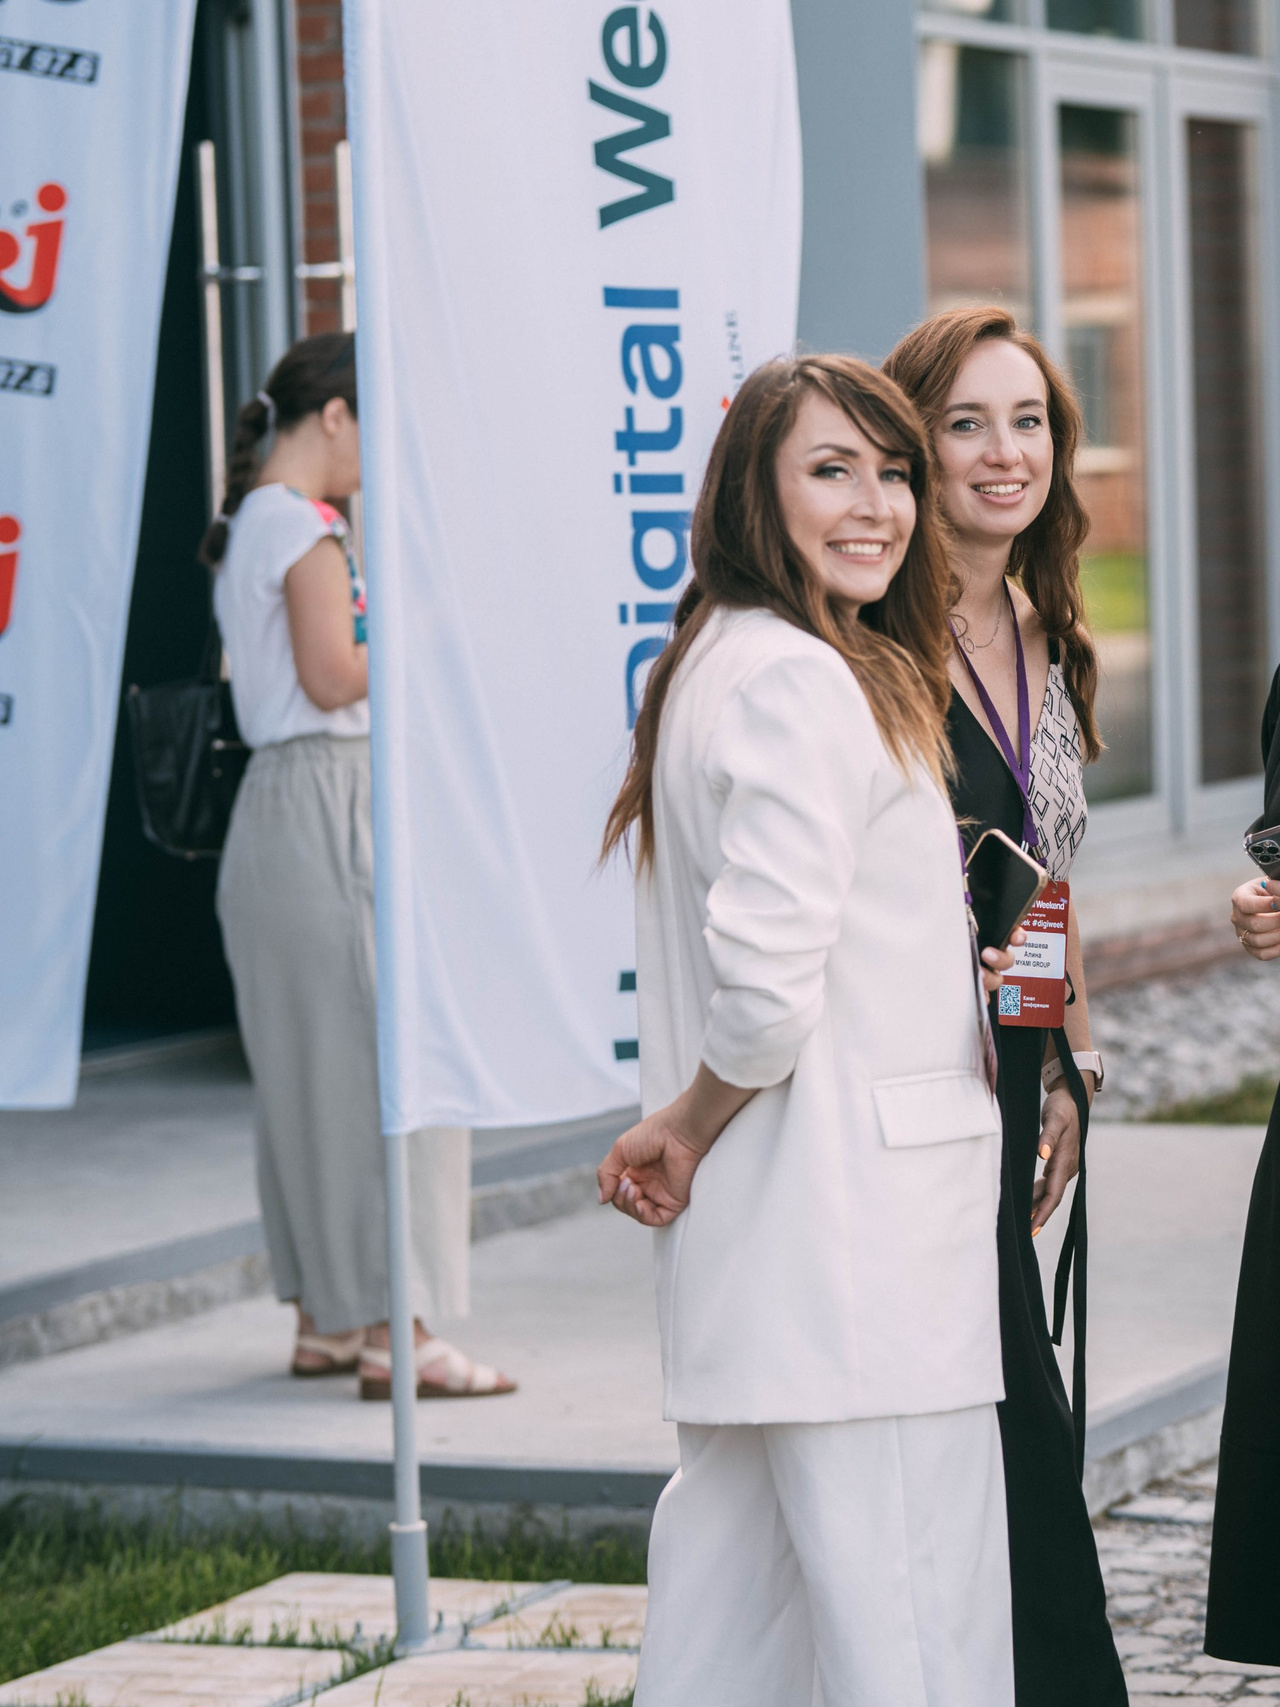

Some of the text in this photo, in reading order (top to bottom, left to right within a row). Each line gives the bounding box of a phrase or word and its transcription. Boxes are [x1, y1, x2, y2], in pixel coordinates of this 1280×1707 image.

[1035, 900, 1065, 911] Weekend
[1032, 919, 1064, 929] #digiweek
[1023, 941, 1049, 950] евашева
[1024, 951, 1042, 959] Алина
[1015, 959, 1051, 968] MYAMI GROUP
